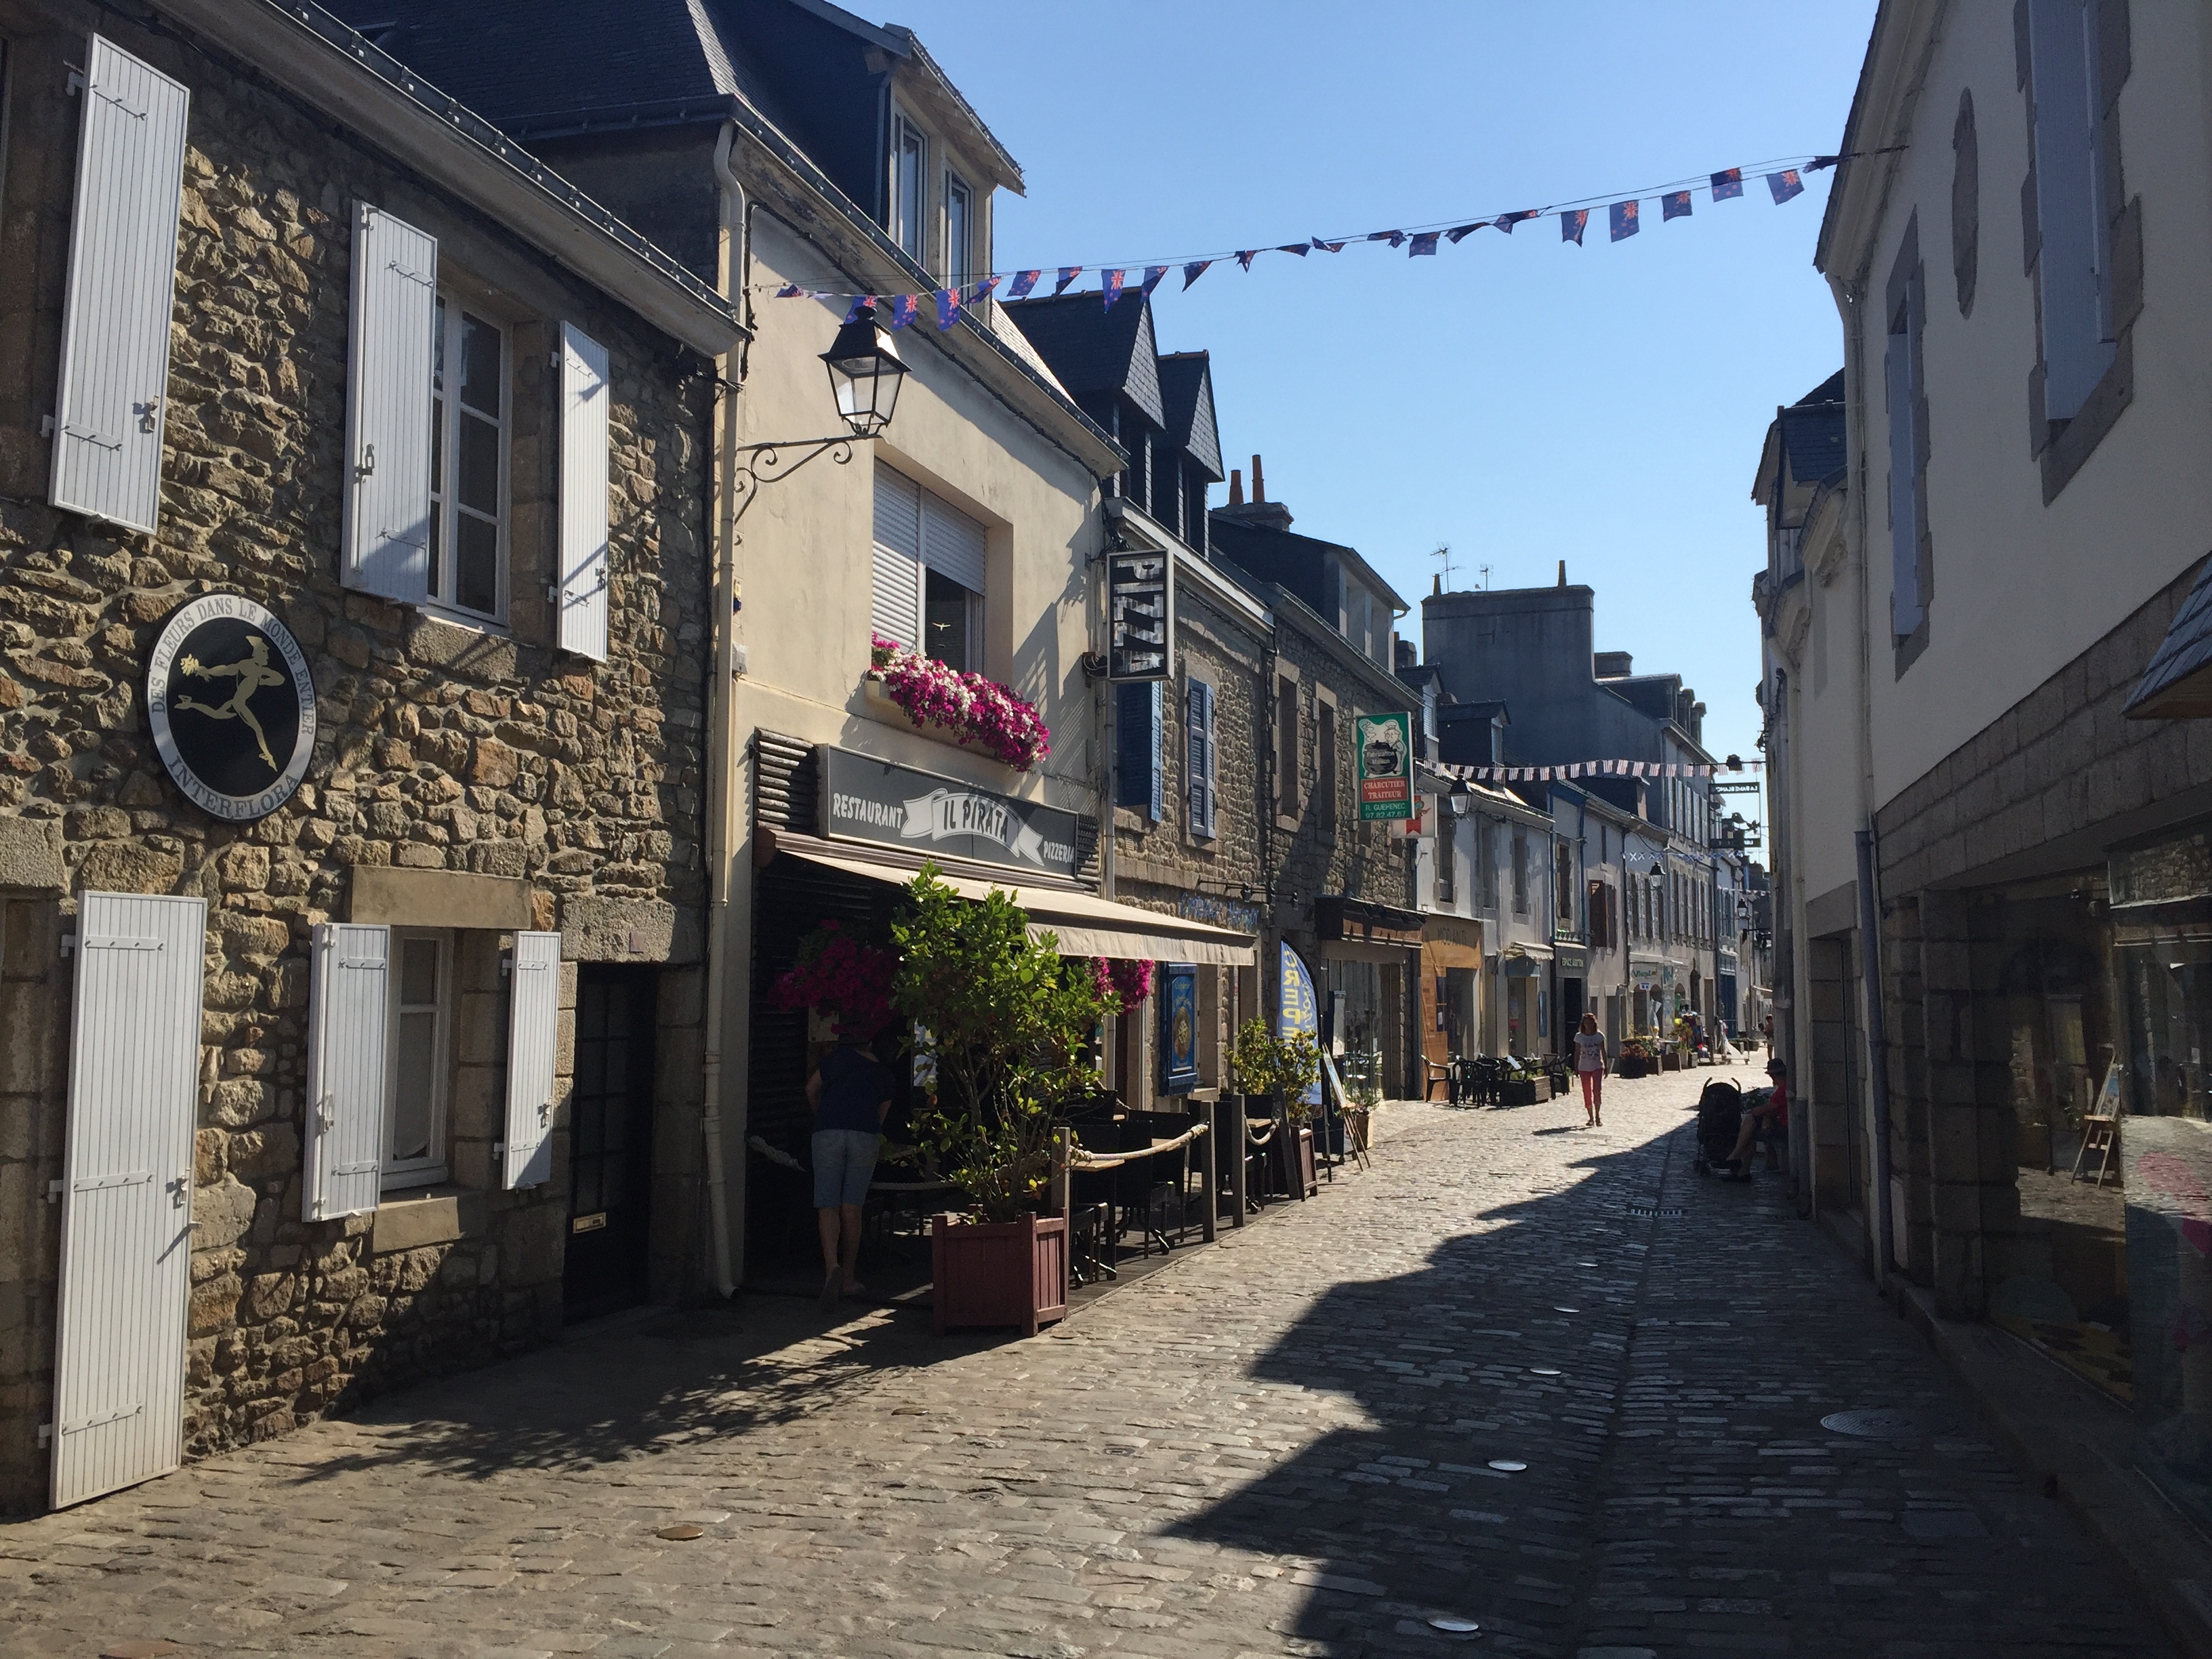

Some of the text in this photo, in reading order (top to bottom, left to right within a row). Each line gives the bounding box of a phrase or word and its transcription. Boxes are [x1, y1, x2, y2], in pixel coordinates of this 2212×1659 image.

[1113, 557, 1164, 674] PIZZA
[150, 597, 314, 735] DES FLEURS DANS LE MONDE ENTIER
[168, 756, 300, 819] INTERFLORA
[1364, 781, 1405, 790] CHARCUTIER
[1368, 791, 1401, 799] TRAITEUR
[833, 792, 1074, 863] RESTAURANT IL PIRATA PIZZERIA
